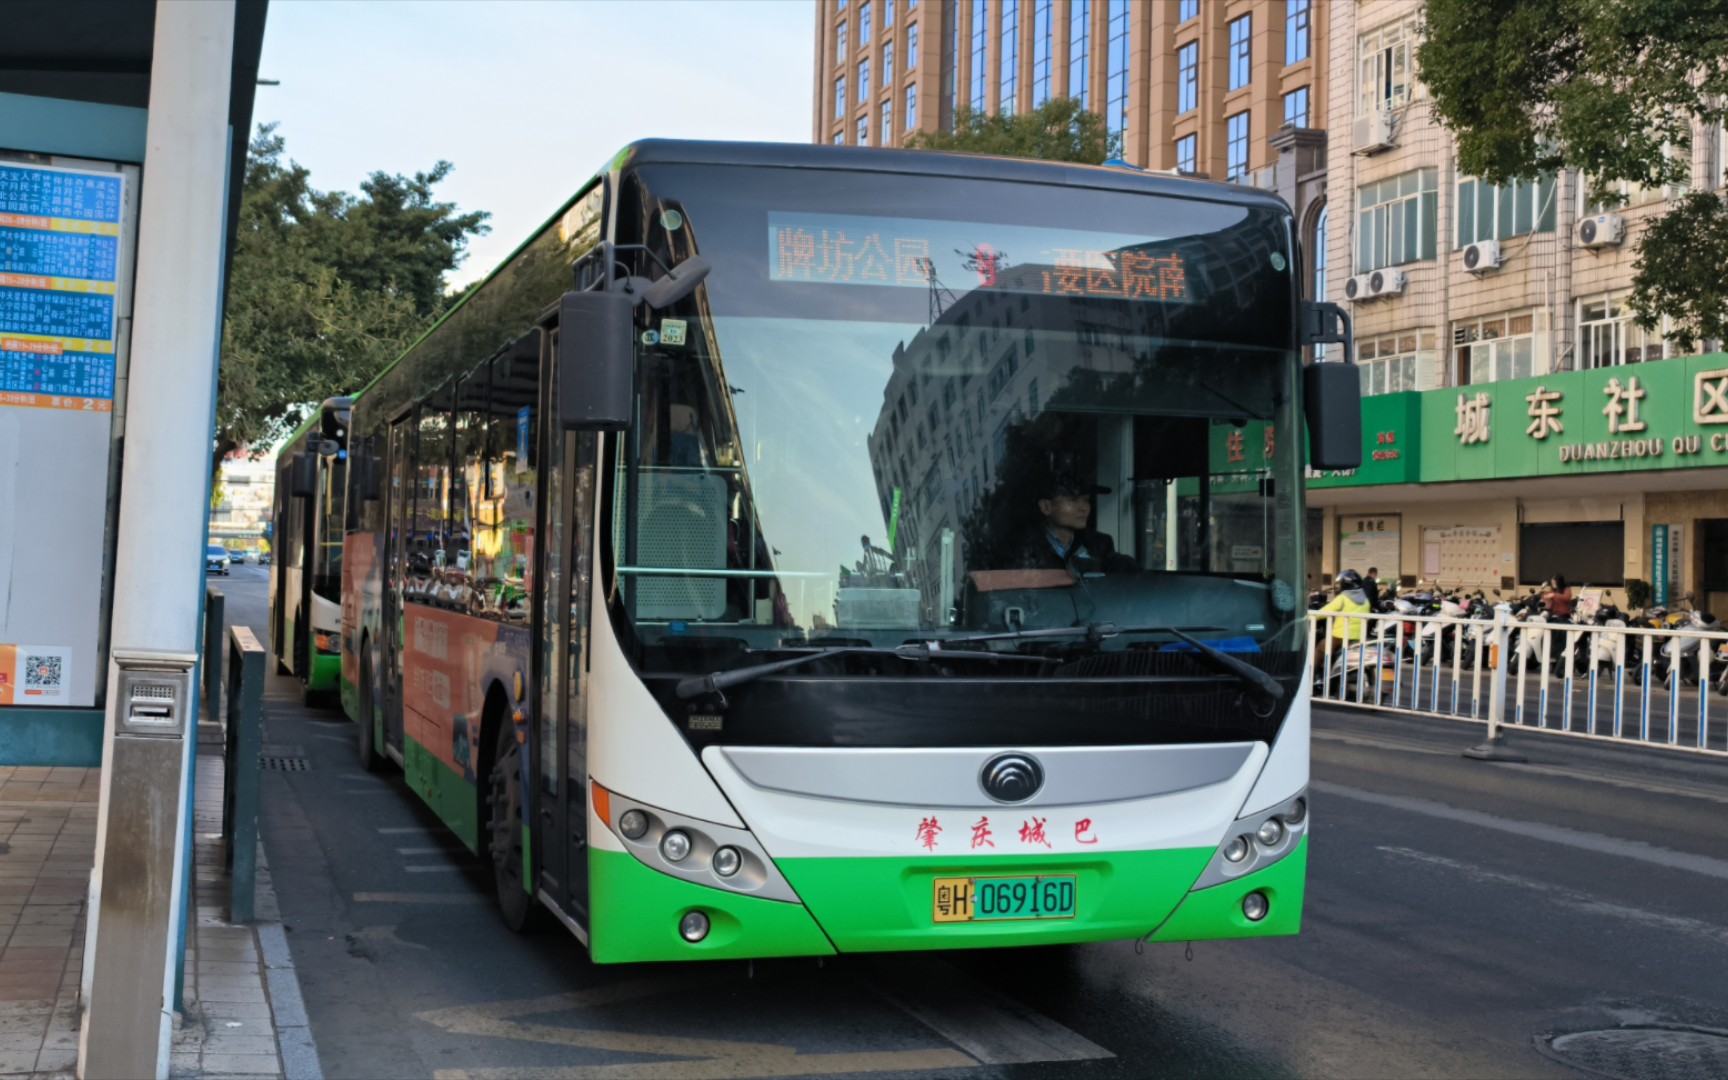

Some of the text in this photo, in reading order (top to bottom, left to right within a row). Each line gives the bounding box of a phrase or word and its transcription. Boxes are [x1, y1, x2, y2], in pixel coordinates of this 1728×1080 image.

[776, 227, 931, 285] 牌坊公园
[1454, 369, 1728, 444] 城东社区
[1559, 433, 1728, 463] DUANZHOU QU C
[915, 815, 1099, 852] 肇庆城巴
